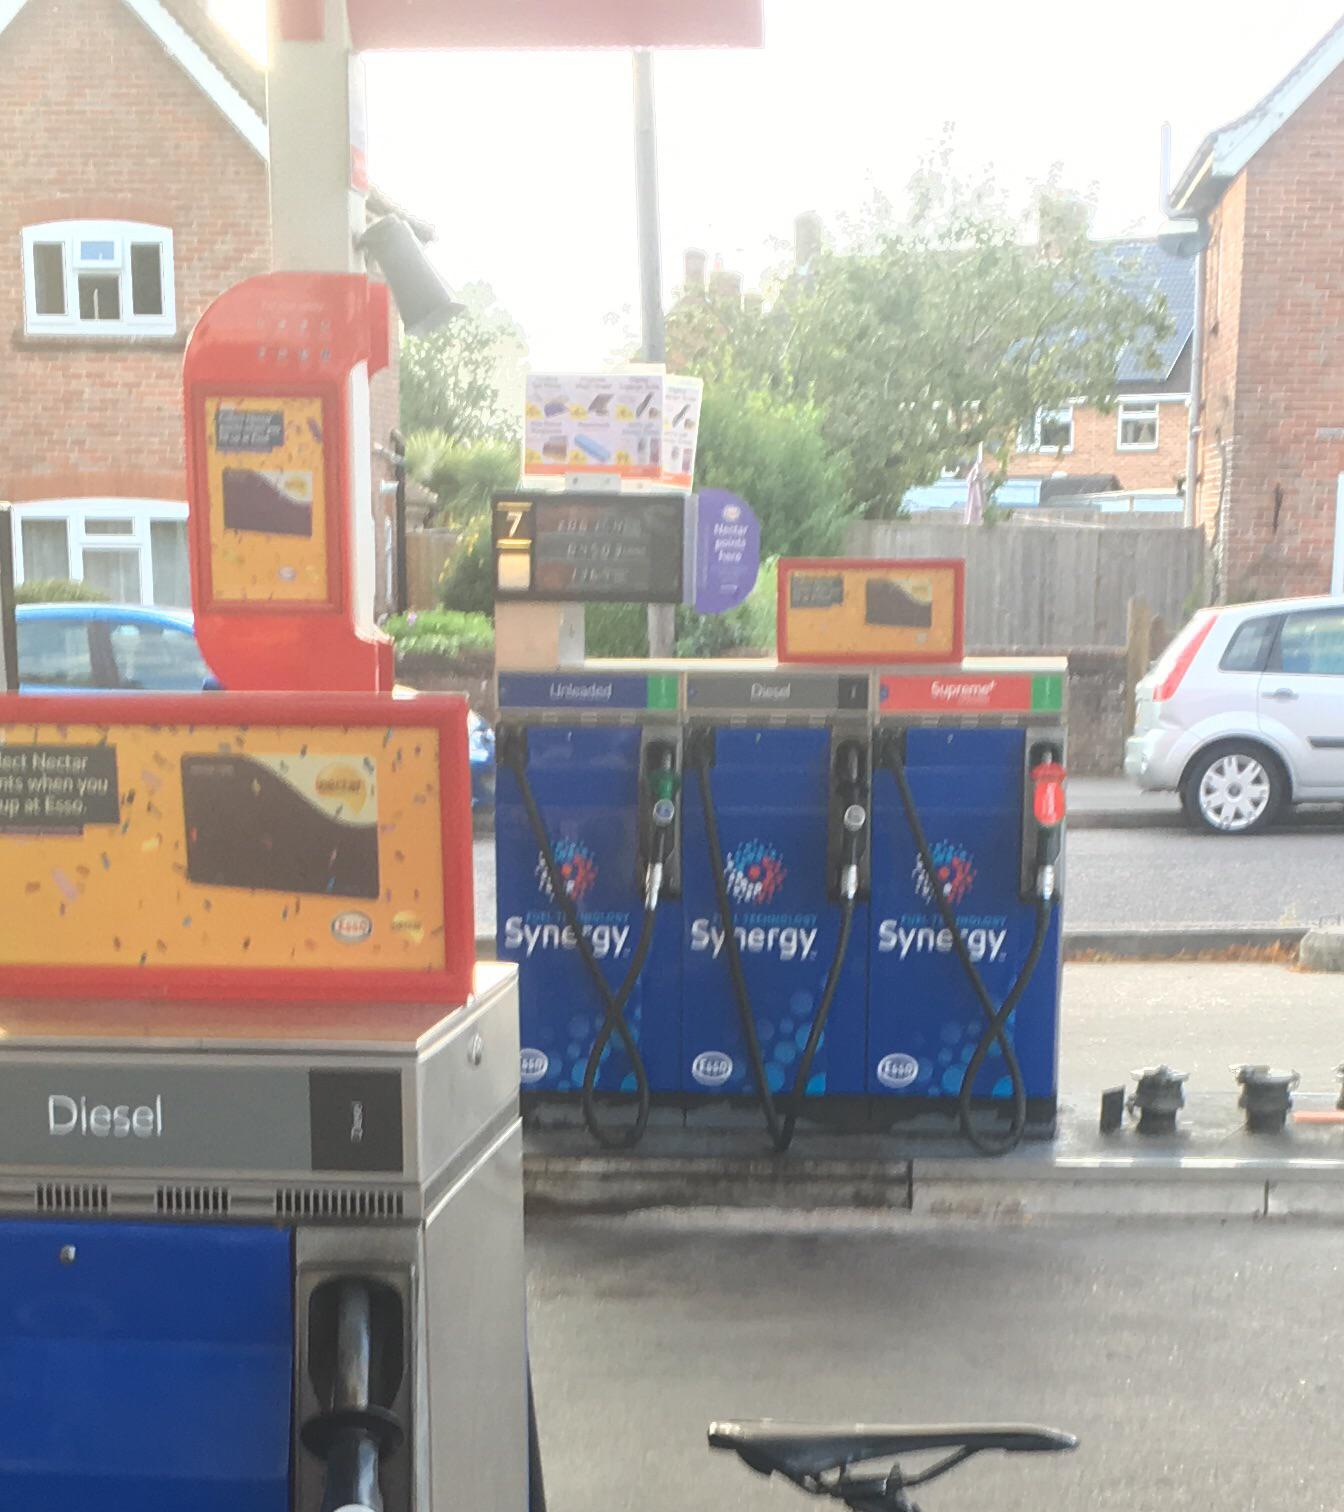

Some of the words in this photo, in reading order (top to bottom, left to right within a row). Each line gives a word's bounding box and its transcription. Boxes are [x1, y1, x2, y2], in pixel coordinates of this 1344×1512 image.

[507, 511, 523, 537] 7
[32, 751, 88, 770] Nectar
[28, 773, 74, 792] when
[77, 777, 108, 796] you
[0, 798, 20, 817] up
[48, 1094, 162, 1138] Diesel
